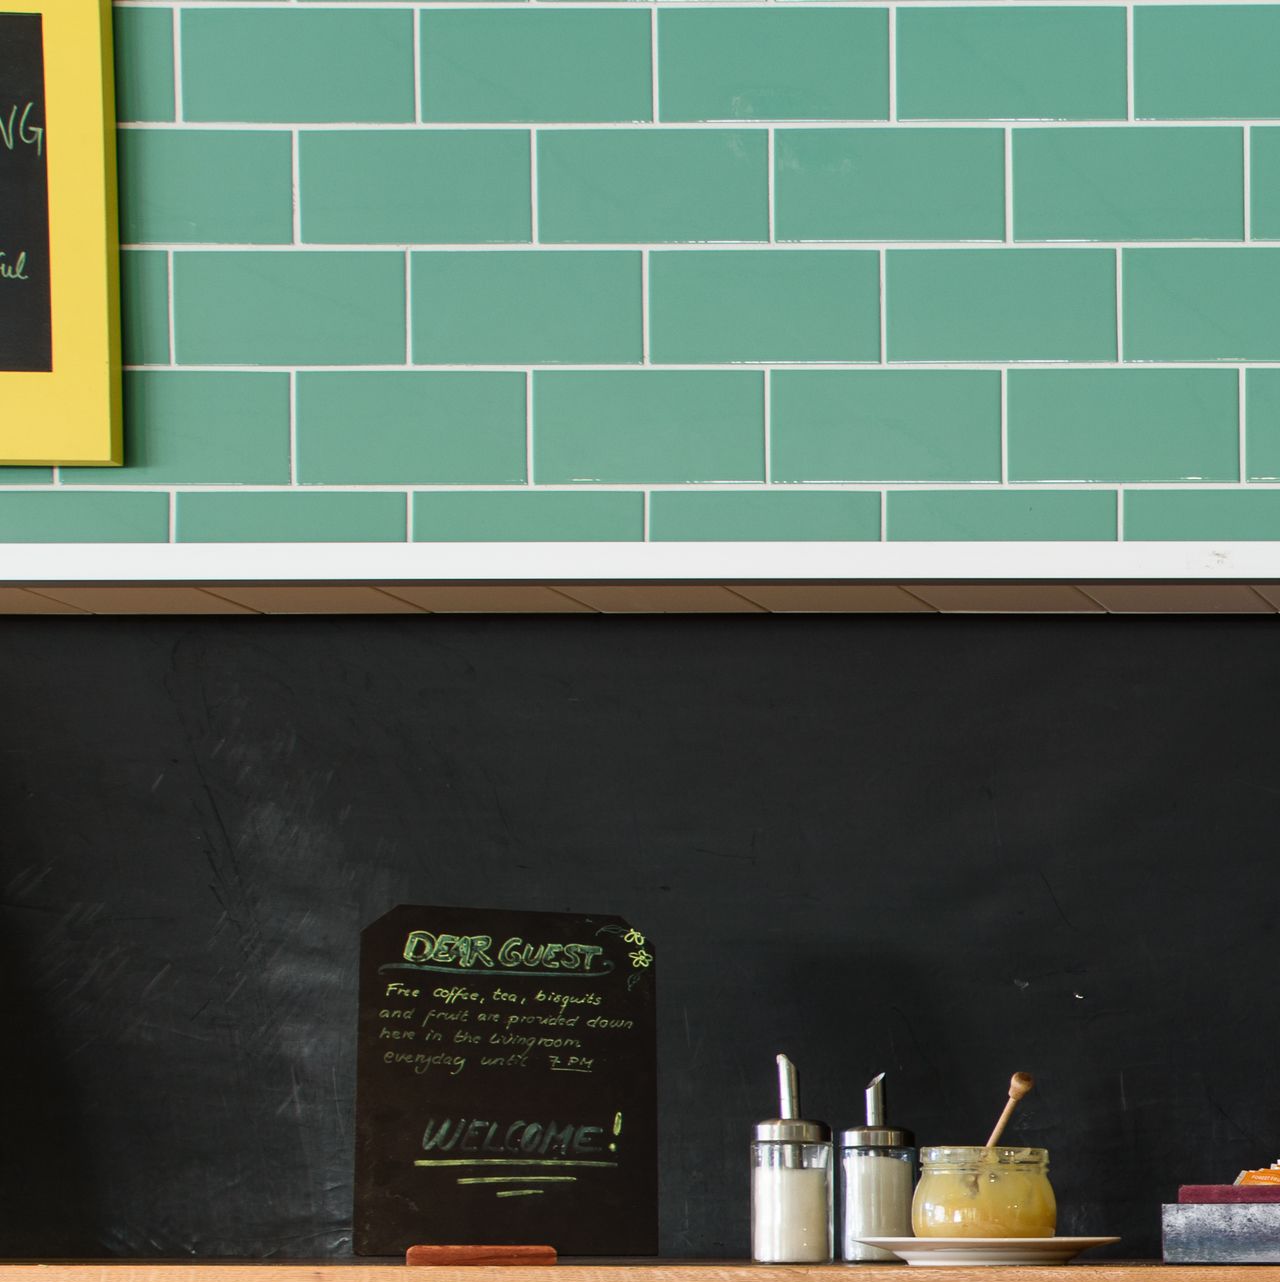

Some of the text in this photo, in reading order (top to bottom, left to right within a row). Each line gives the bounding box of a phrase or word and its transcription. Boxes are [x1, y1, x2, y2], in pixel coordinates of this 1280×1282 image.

[403, 930, 603, 970] DEAR GUEST
[386, 982, 602, 1014] Free coffee, tea, bisquits
[379, 1008, 634, 1030] and fruit are provided down
[379, 1028, 416, 1041] here
[425, 1029, 443, 1041] in
[453, 1029, 481, 1044] the
[383, 1050, 467, 1076] everyday
[568, 1056, 594, 1069] PM
